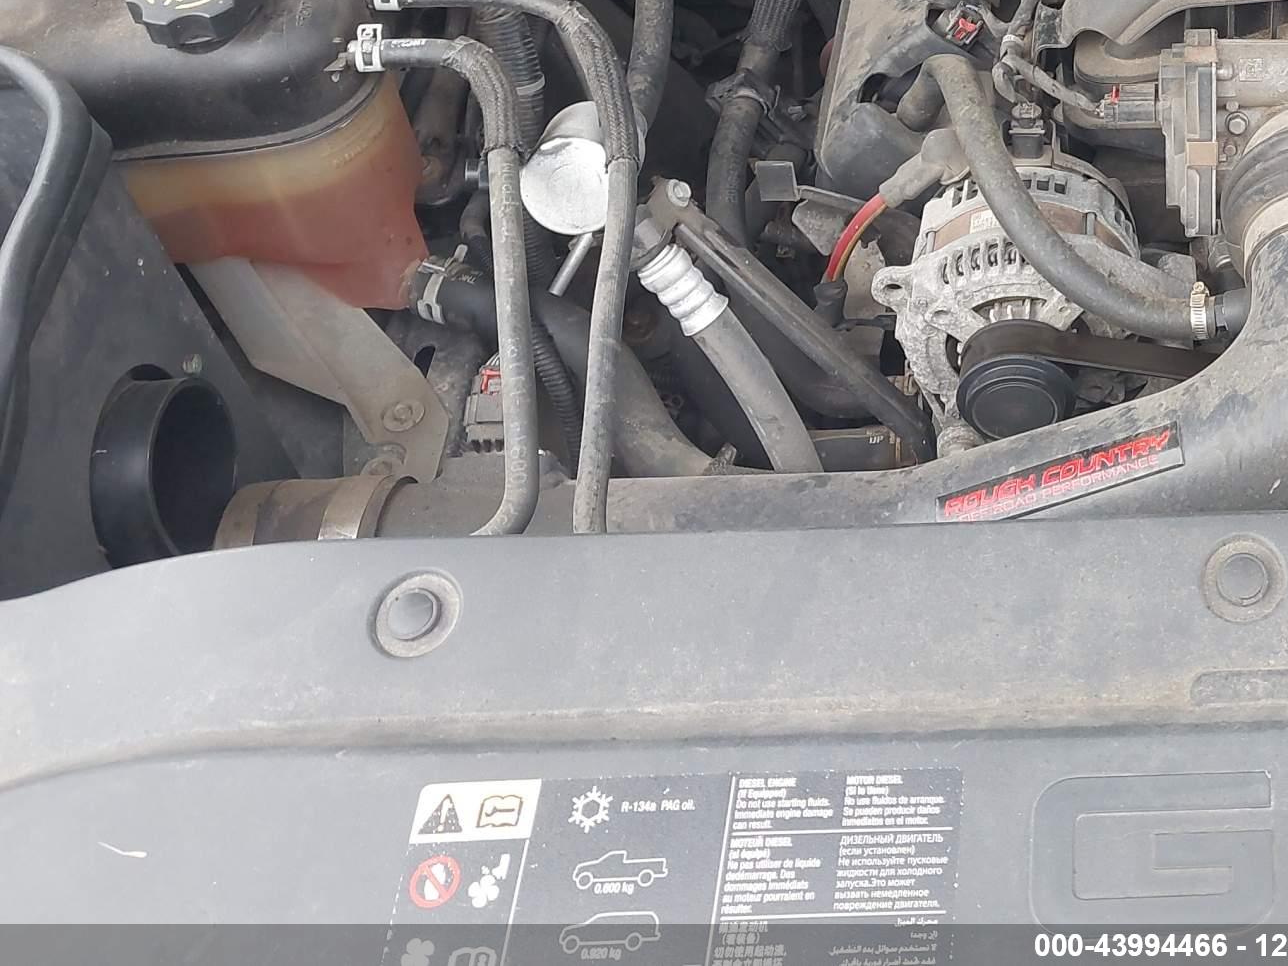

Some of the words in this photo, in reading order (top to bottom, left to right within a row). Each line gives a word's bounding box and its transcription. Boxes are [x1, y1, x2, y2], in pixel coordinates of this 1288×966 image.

[1042, 429, 1172, 487] COUNTRY
[1042, 457, 1160, 500] PERFORMANCE
[620, 801, 657, 812] R-134a
[660, 800, 680, 811] PAG
[681, 799, 696, 810] oil.
[748, 799, 761, 808] not
[762, 799, 776, 808] use
[777, 798, 807, 809] starting
[872, 796, 897, 805] fluidos
[898, 796, 908, 804] de
[734, 809, 774, 819] Immediate
[775, 809, 802, 820] engine
[803, 808, 834, 818] damage
[843, 806, 854, 816] Se
[855, 806, 883, 817] pueden
[884, 805, 916, 816] producir
[917, 805, 941, 814] daños
[732, 821, 747, 830] can
[840, 834, 895, 846] ДИЗЕЛЬНЫЙ
[895, 833, 944, 844] ДВИГАТЕЛЬ
[839, 847, 862, 857] (если
[863, 845, 916, 856] установлен)
[739, 861, 754, 870] pas
[755, 859, 782, 869] utiliser
[783, 859, 794, 868] de
[795, 858, 821, 869] liquide
[838, 857, 850, 866] Не
[851, 856, 905, 867] используйте
[907, 856, 949, 866] пусковые
[836, 869, 878, 878] жидкости
[879, 868, 896, 877] для
[897, 867, 943, 877] холодного
[622, 882, 635, 894] kg
[724, 882, 767, 893] dommages
[888, 878, 916, 887] может
[734, 893, 762, 903] moteur
[763, 891, 803, 903] pourraient
[834, 891, 869, 900] вызвать
[871, 889, 930, 899] немедленное
[833, 901, 893, 911] повреждение
[894, 900, 941, 910] двигателя.
[608, 947, 622, 960] kg
